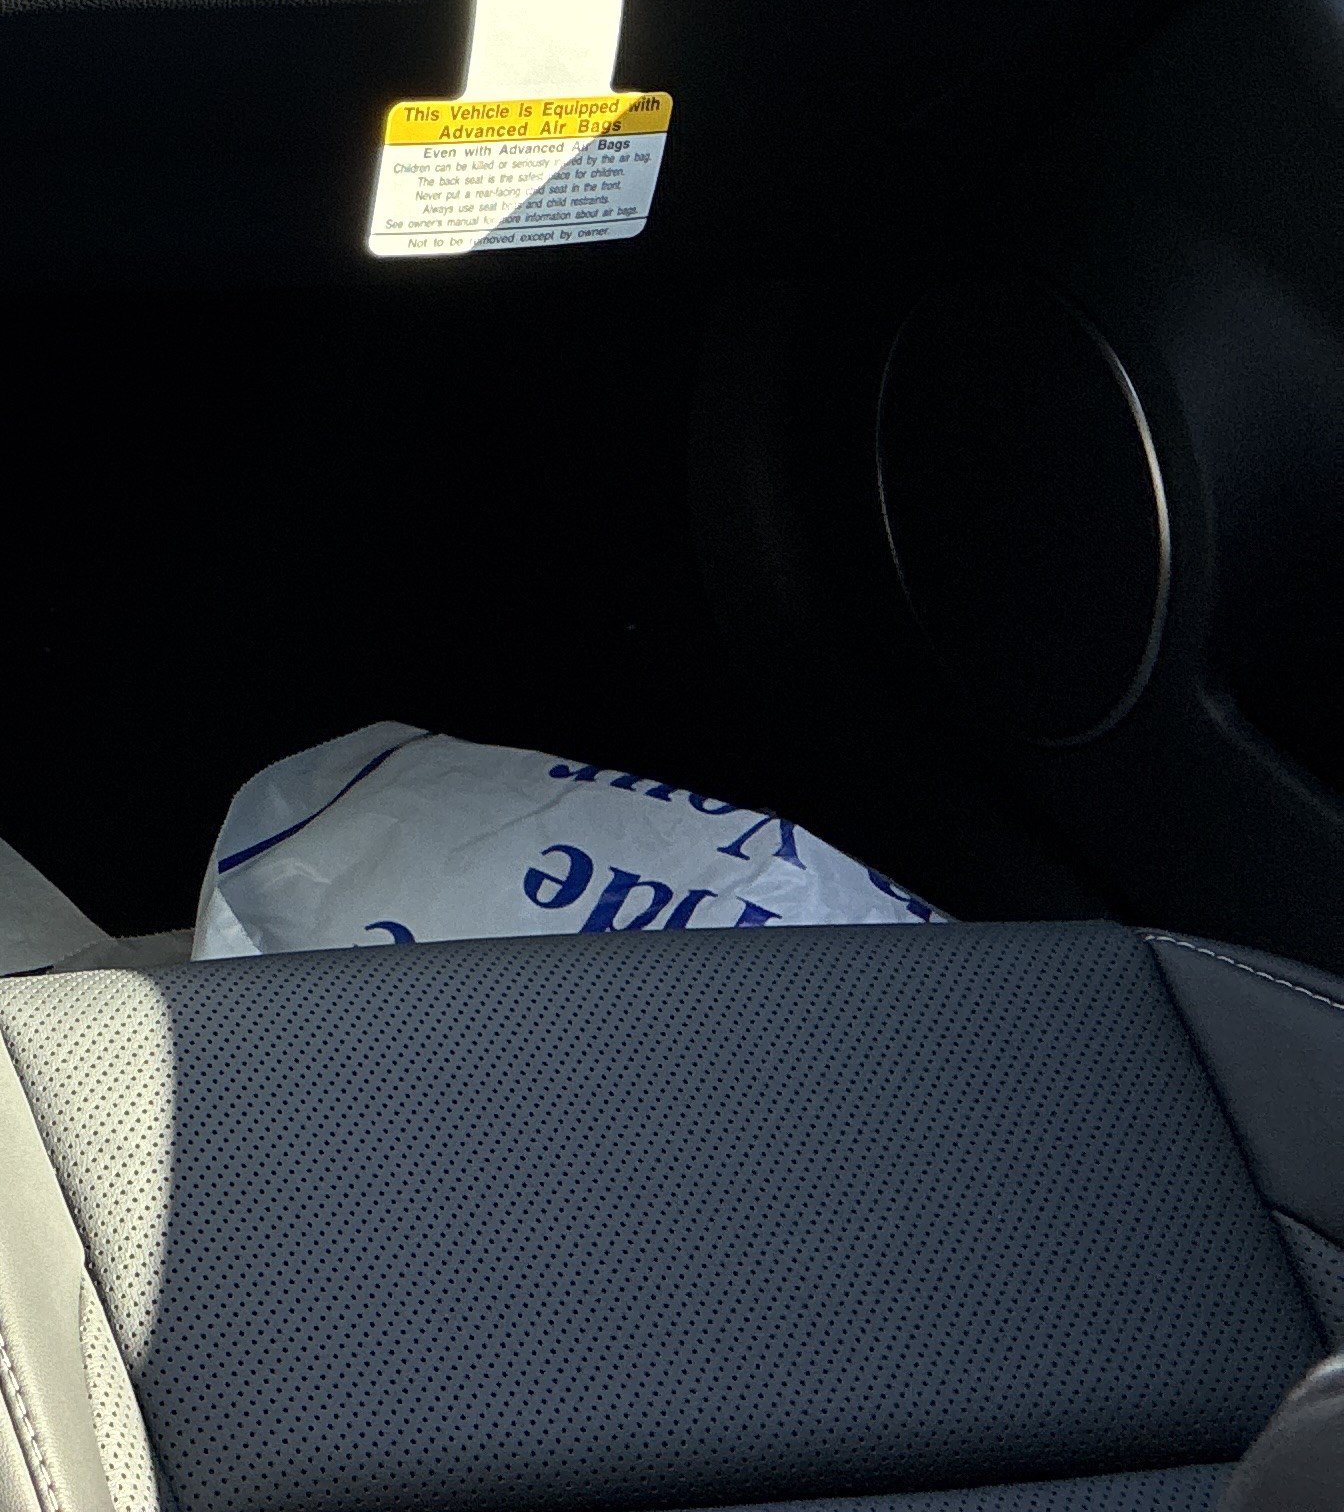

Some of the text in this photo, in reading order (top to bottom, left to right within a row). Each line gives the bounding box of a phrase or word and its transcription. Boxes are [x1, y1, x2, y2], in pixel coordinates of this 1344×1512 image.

[404, 95, 660, 123] This Vehicle is Equipped with
[438, 117, 621, 141] Advanced Air Bags
[423, 146, 456, 159] Even
[464, 145, 491, 157] with
[498, 140, 565, 156] Advanced
[597, 137, 630, 152] Bags
[393, 161, 430, 174] Children
[434, 162, 451, 172] can
[455, 161, 467, 171] be
[471, 160, 494, 170] killed
[498, 161, 507, 169] or
[586, 156, 598, 166] by
[601, 154, 615, 163] the
[618, 153, 630, 162] air
[418, 176, 434, 187] The
[438, 175, 460, 186] back
[464, 174, 483, 185] seat
[547, 171, 570, 181] lace
[415, 190, 441, 201] Never
[445, 189, 461, 201] put
[422, 203, 454, 216] Always
[458, 204, 474, 213] use
[478, 202, 497, 211] seat
[524, 199, 543, 209] and
[545, 196, 567, 207] child
[385, 218, 403, 229] See
[407, 238, 427, 248] Not
[433, 238, 443, 247] to
[519, 230, 555, 243] except
[559, 229, 572, 240] by
